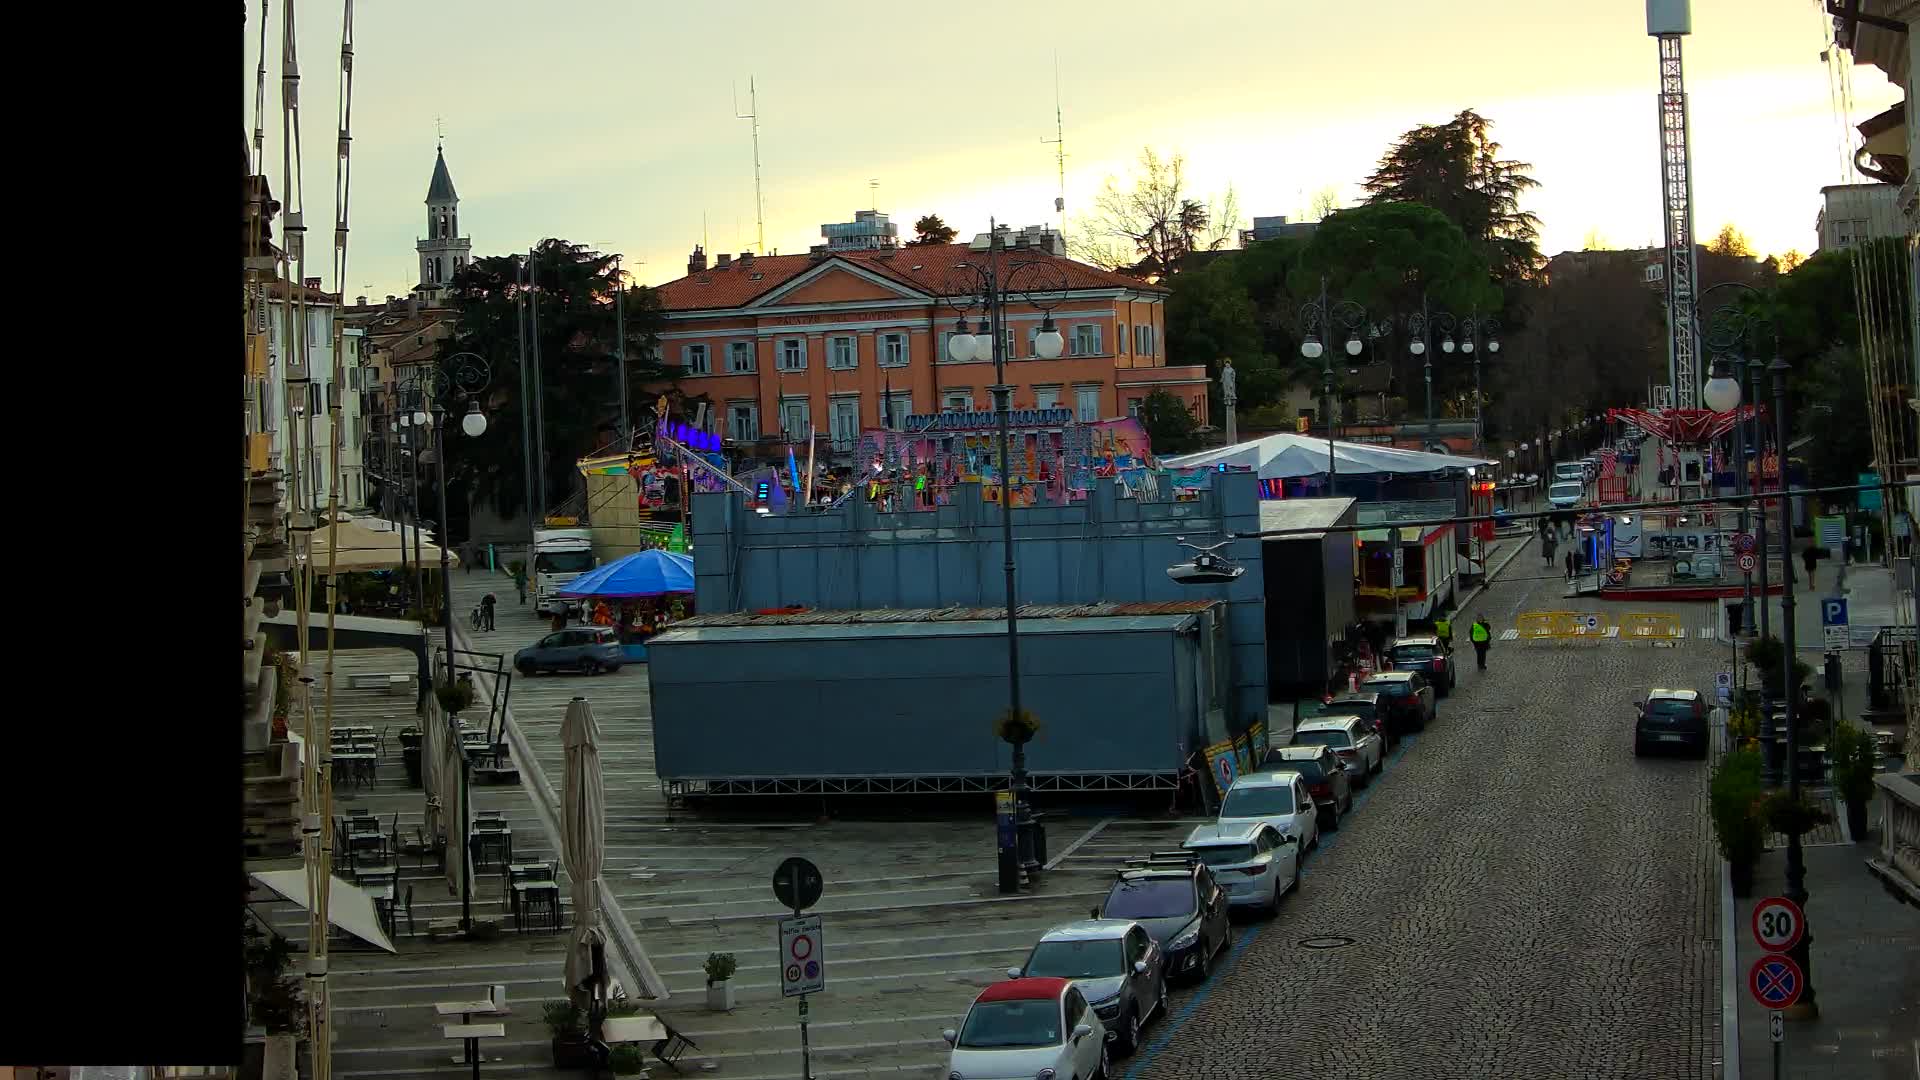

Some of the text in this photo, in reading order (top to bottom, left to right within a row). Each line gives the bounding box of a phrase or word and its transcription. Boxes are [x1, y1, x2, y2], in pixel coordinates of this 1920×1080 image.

[1742, 557, 1753, 567] 20
[1828, 603, 1842, 622] P
[1761, 911, 1792, 938] 30
